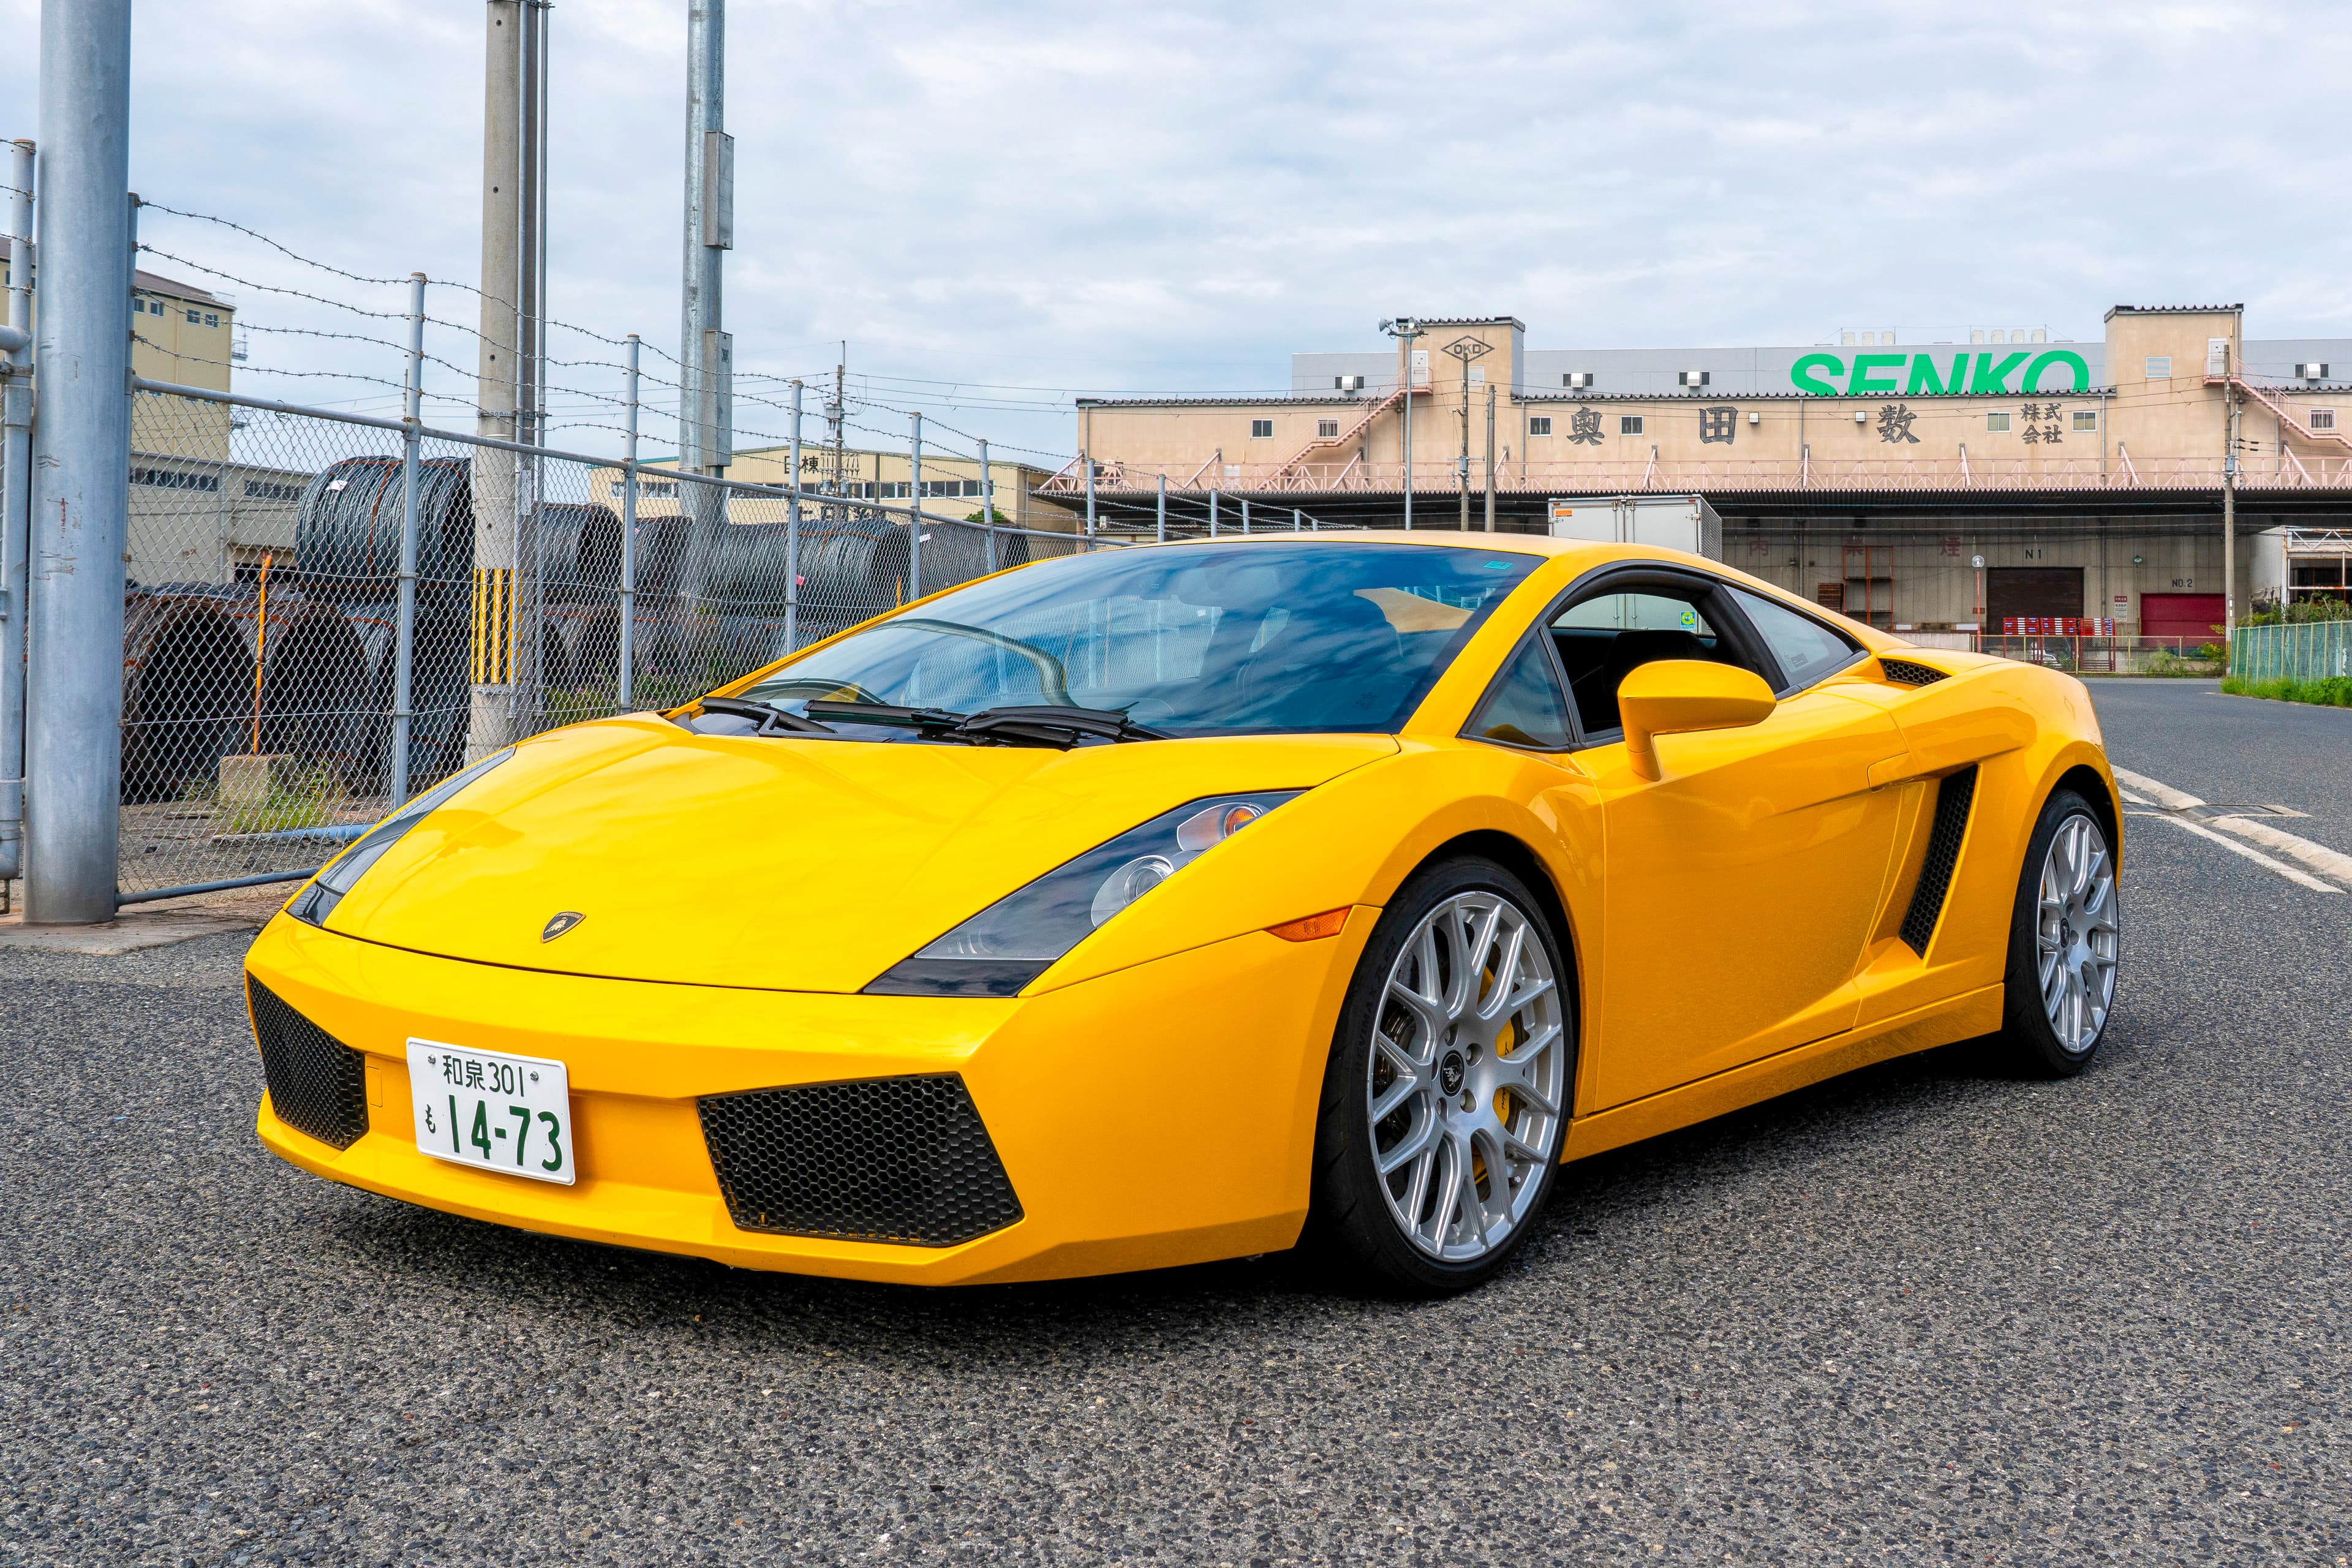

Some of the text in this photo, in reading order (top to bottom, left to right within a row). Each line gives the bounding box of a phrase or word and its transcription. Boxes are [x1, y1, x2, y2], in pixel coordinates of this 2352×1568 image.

[1454, 344, 1482, 355] OKD
[1791, 350, 2090, 395] SENKO
[424, 1094, 563, 1172] も 14-73
